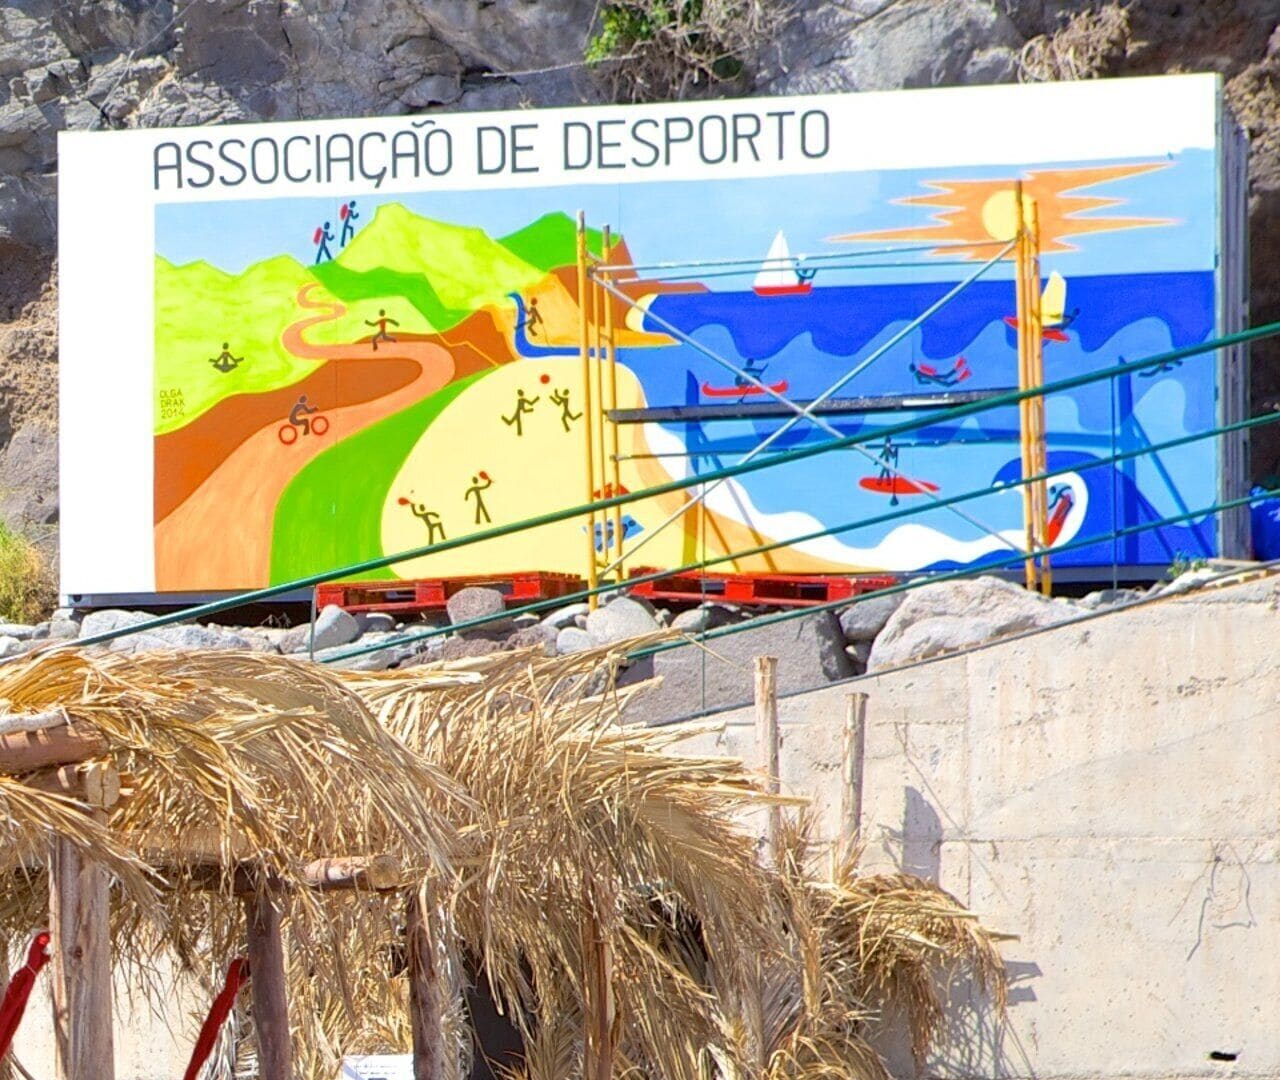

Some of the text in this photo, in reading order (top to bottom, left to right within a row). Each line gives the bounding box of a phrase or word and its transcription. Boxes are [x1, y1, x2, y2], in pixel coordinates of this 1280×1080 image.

[153, 109, 830, 190] ASSOCIAÇÃO DE DESPORTO
[159, 388, 183, 399] OLGA
